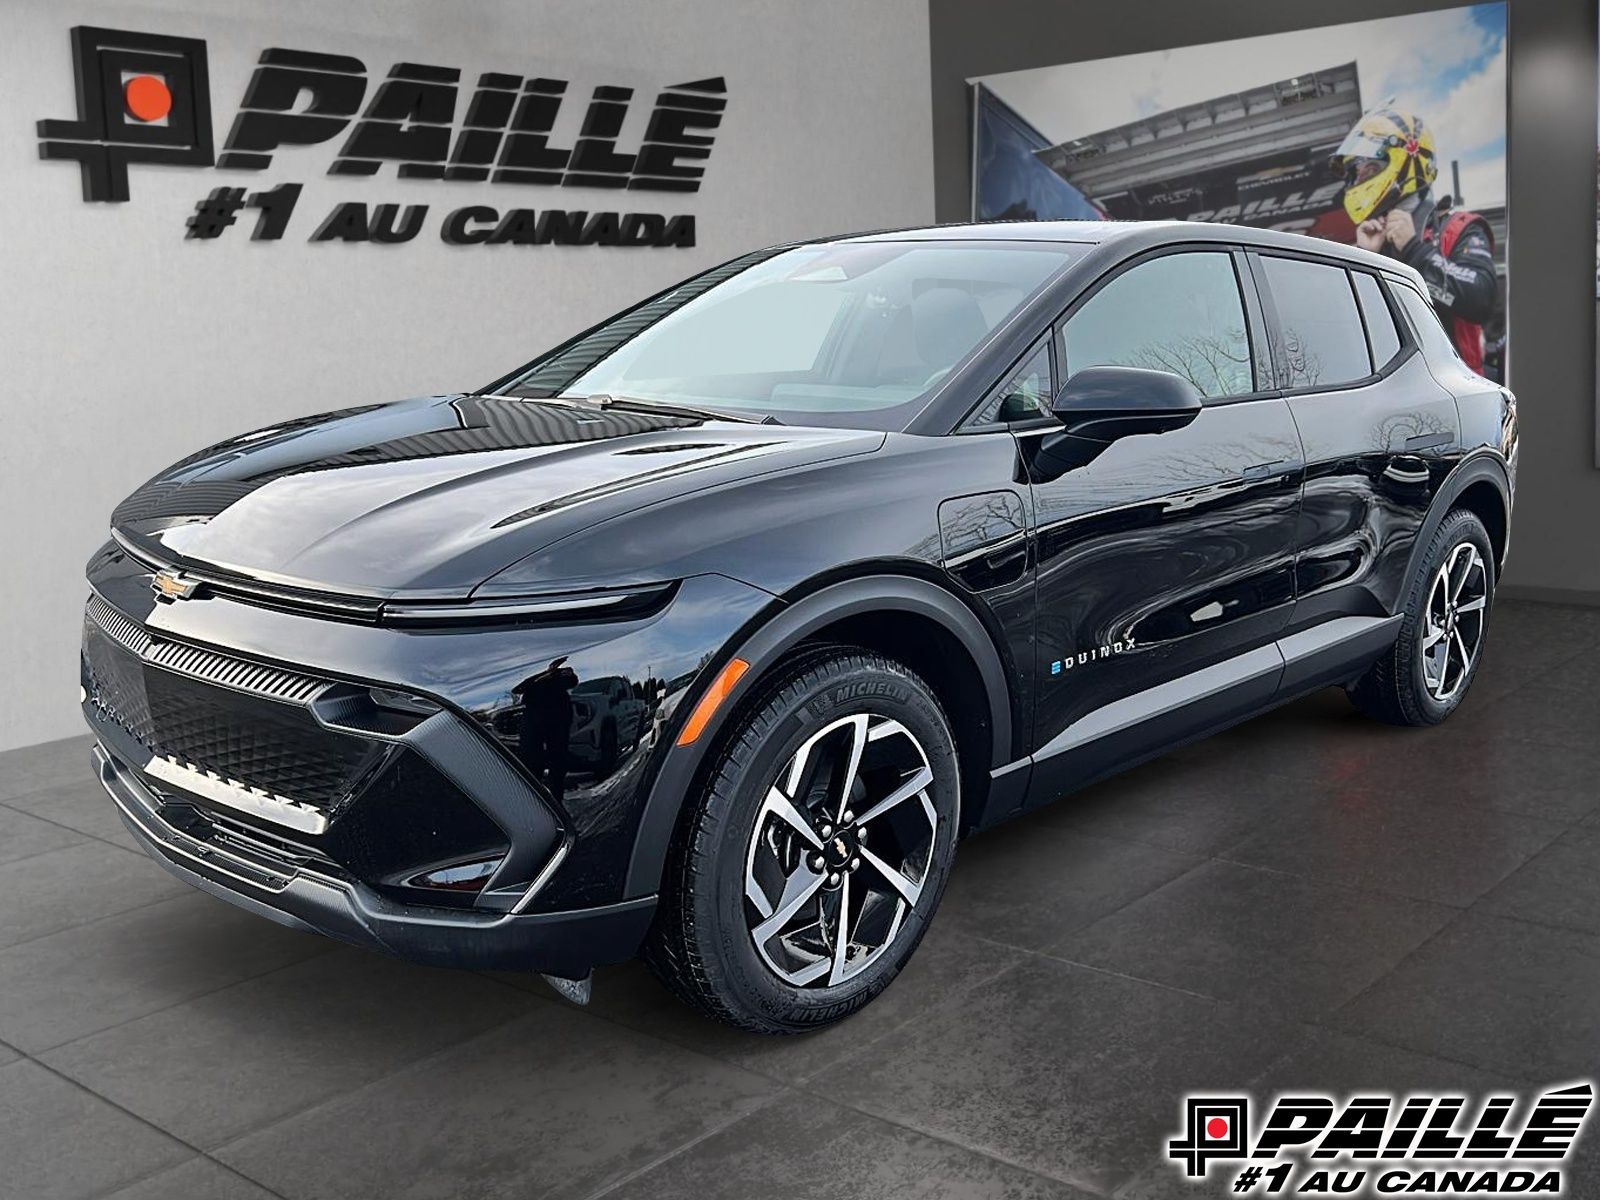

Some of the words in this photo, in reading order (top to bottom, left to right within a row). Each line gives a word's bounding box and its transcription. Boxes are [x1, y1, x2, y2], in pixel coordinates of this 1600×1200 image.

[214, 47, 728, 193] PAILLÉ
[184, 182, 304, 242] #1
[308, 201, 430, 244] AU
[439, 204, 697, 248] CANADA
[1051, 637, 1136, 675] EQUINOX
[835, 681, 910, 703] MICHELIN
